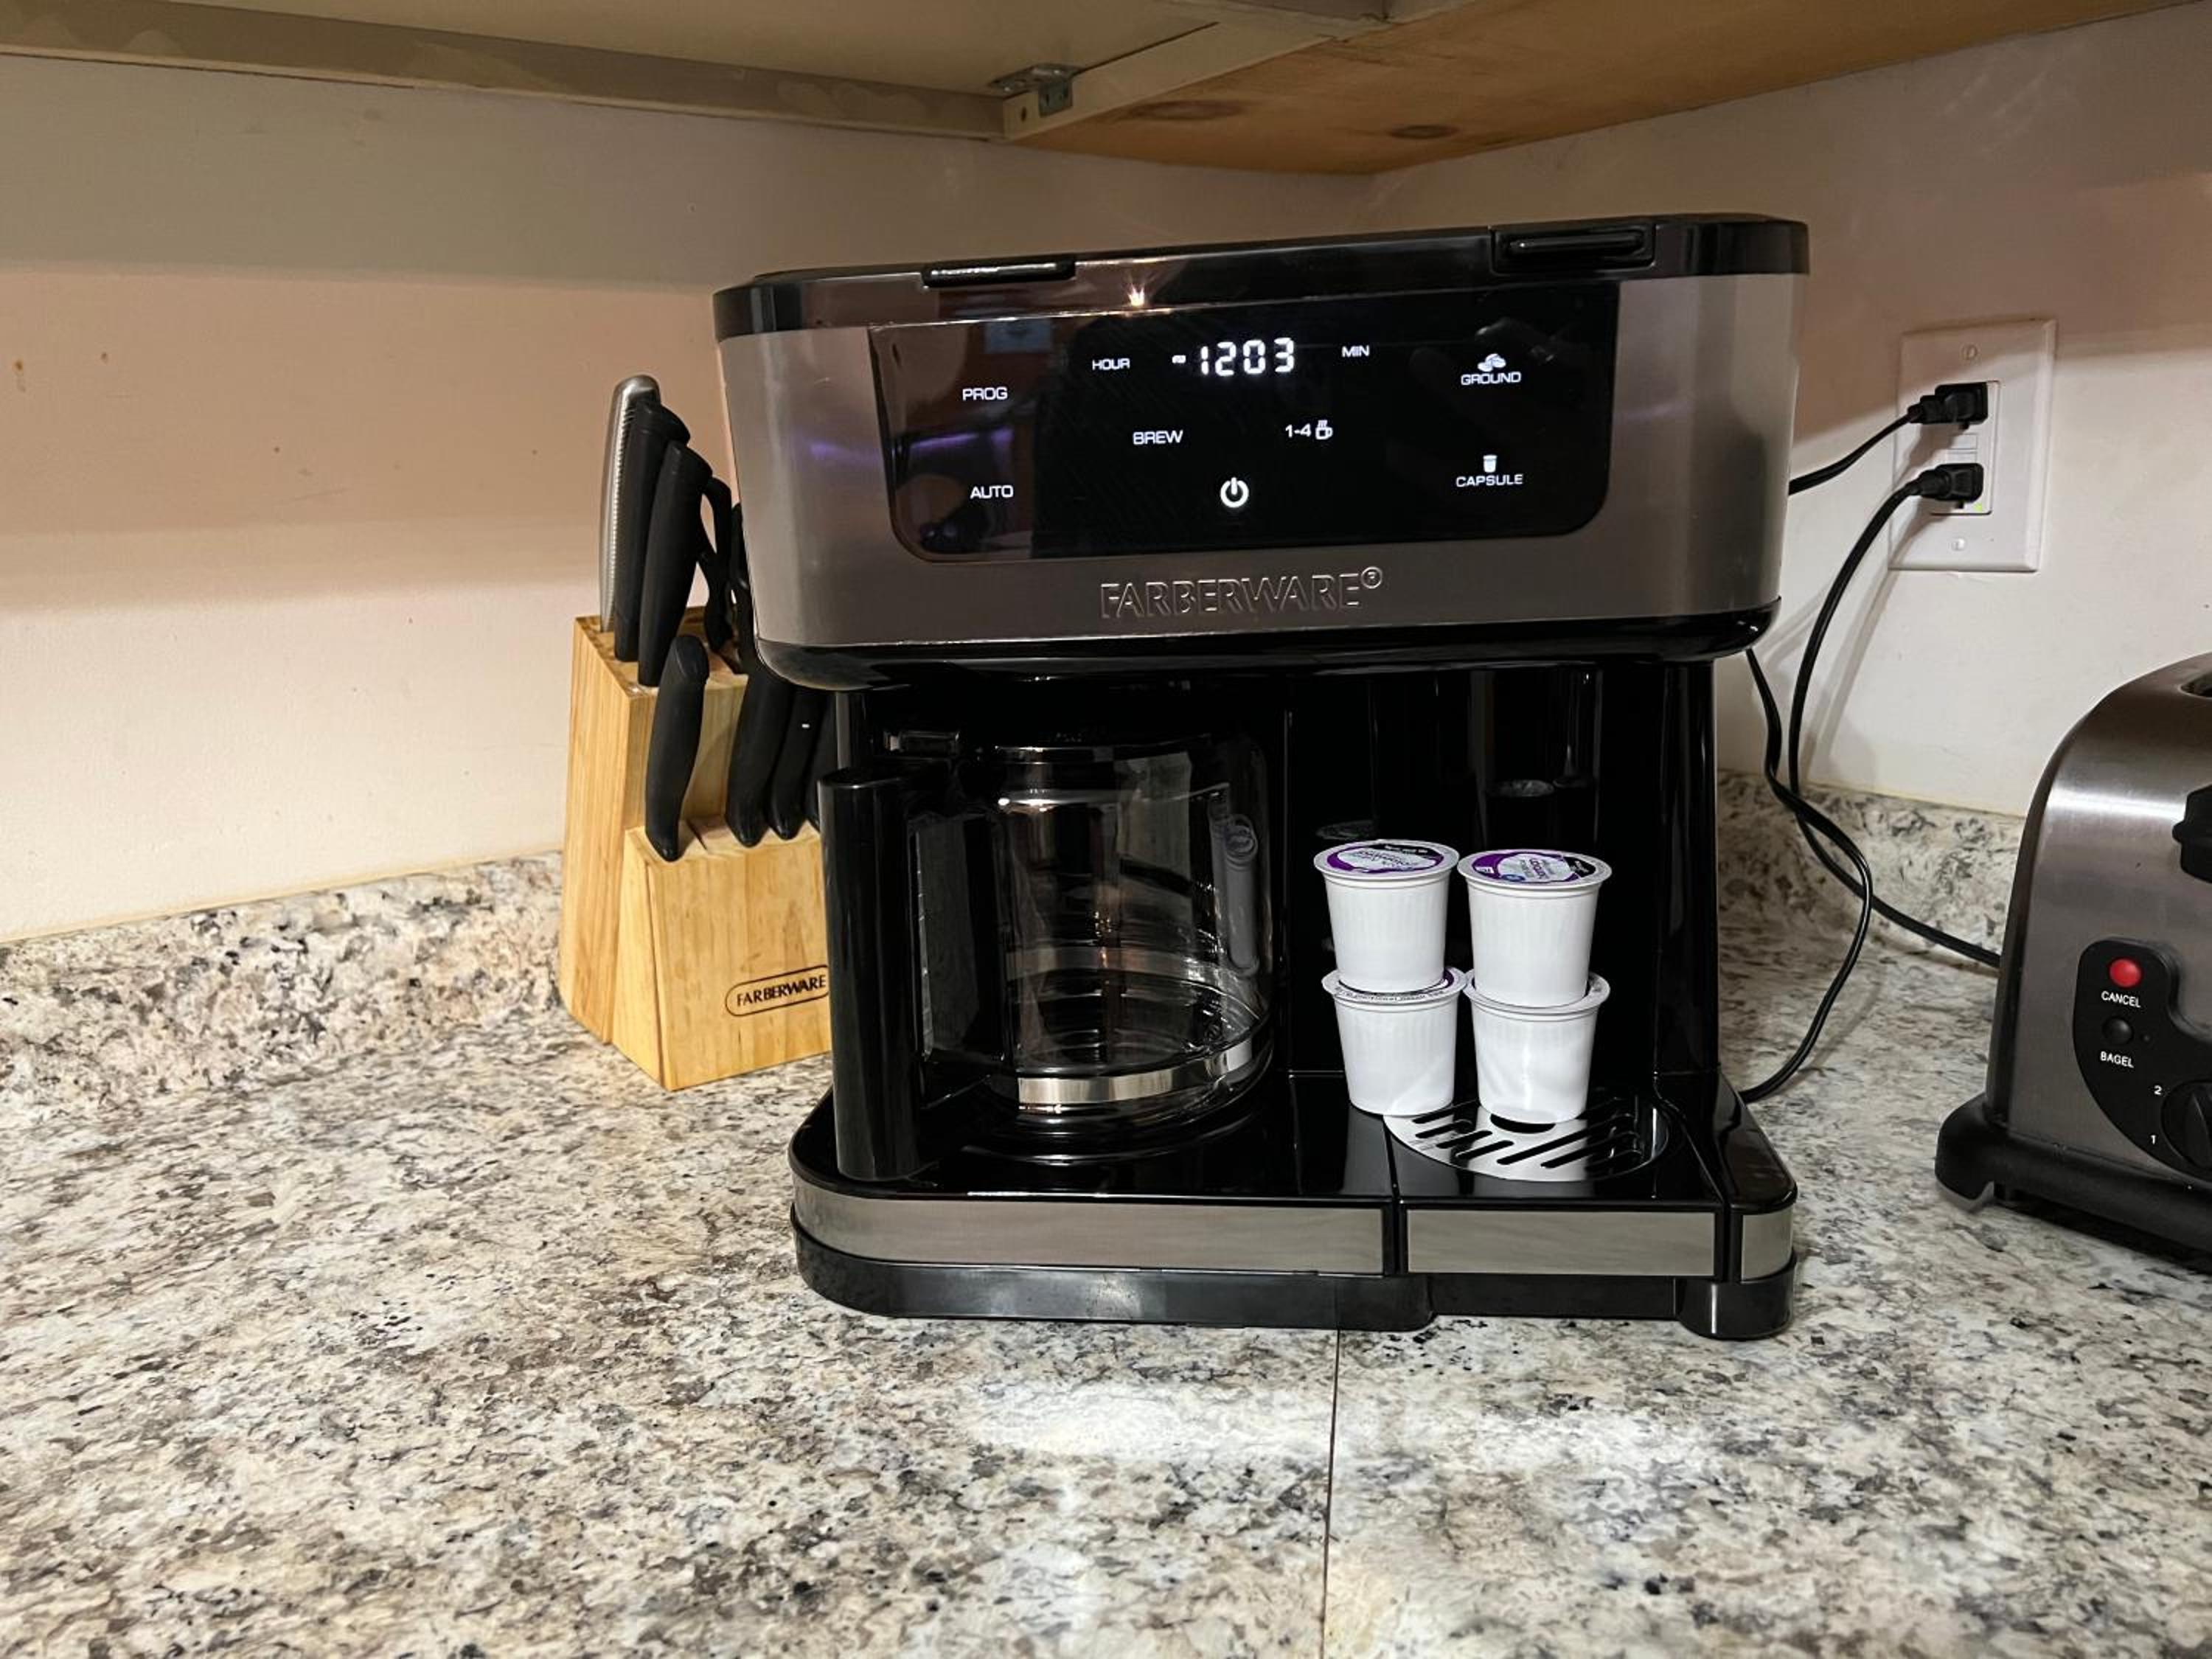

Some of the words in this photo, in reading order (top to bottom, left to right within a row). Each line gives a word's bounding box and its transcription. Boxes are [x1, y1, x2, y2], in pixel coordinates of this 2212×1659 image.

[1341, 345, 1370, 358] MIN
[1092, 358, 1130, 370] HOUR
[1461, 372, 1522, 386] GROUND
[962, 386, 1008, 401] PROG
[1133, 430, 1183, 445] BREW
[1285, 423, 1311, 438] 1-4
[1455, 473, 1523, 487] CAPSULE
[970, 484, 1014, 499] AUTO
[737, 974, 826, 1007] FARBERWARE
[2101, 990, 2141, 1008] CANCEL
[2100, 1051, 2134, 1068] BAGEL
[2154, 1085, 2163, 1096] 2
[2150, 1135, 2157, 1145] 1
